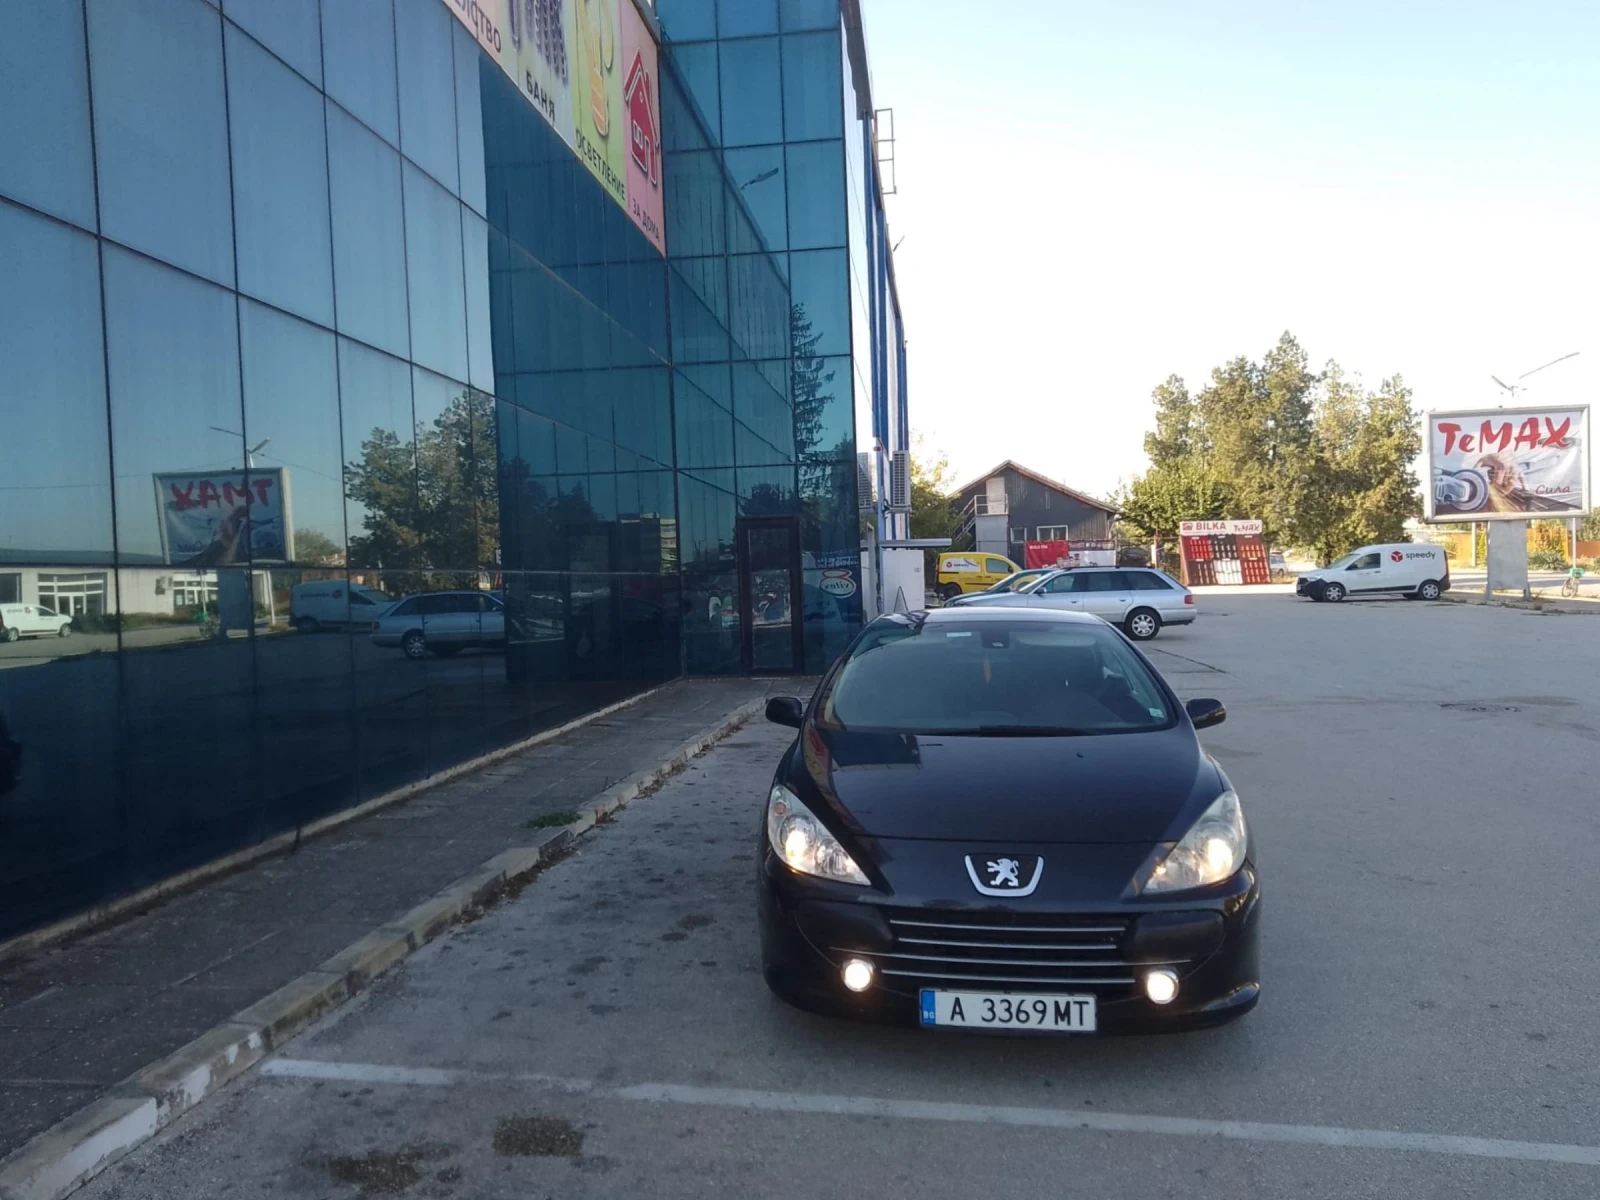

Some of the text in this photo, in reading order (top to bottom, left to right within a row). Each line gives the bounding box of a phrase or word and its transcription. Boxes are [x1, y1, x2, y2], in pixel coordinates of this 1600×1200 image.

[526, 69, 555, 123] БАНЯ
[575, 127, 626, 202] ОСВЕТЛЕНИЕ
[632, 197, 661, 243] ЗА ДОМА
[1437, 416, 1571, 456] TeMAX
[1195, 521, 1227, 531] BILKA
[1406, 551, 1436, 560] speedy
[950, 997, 966, 1022] A
